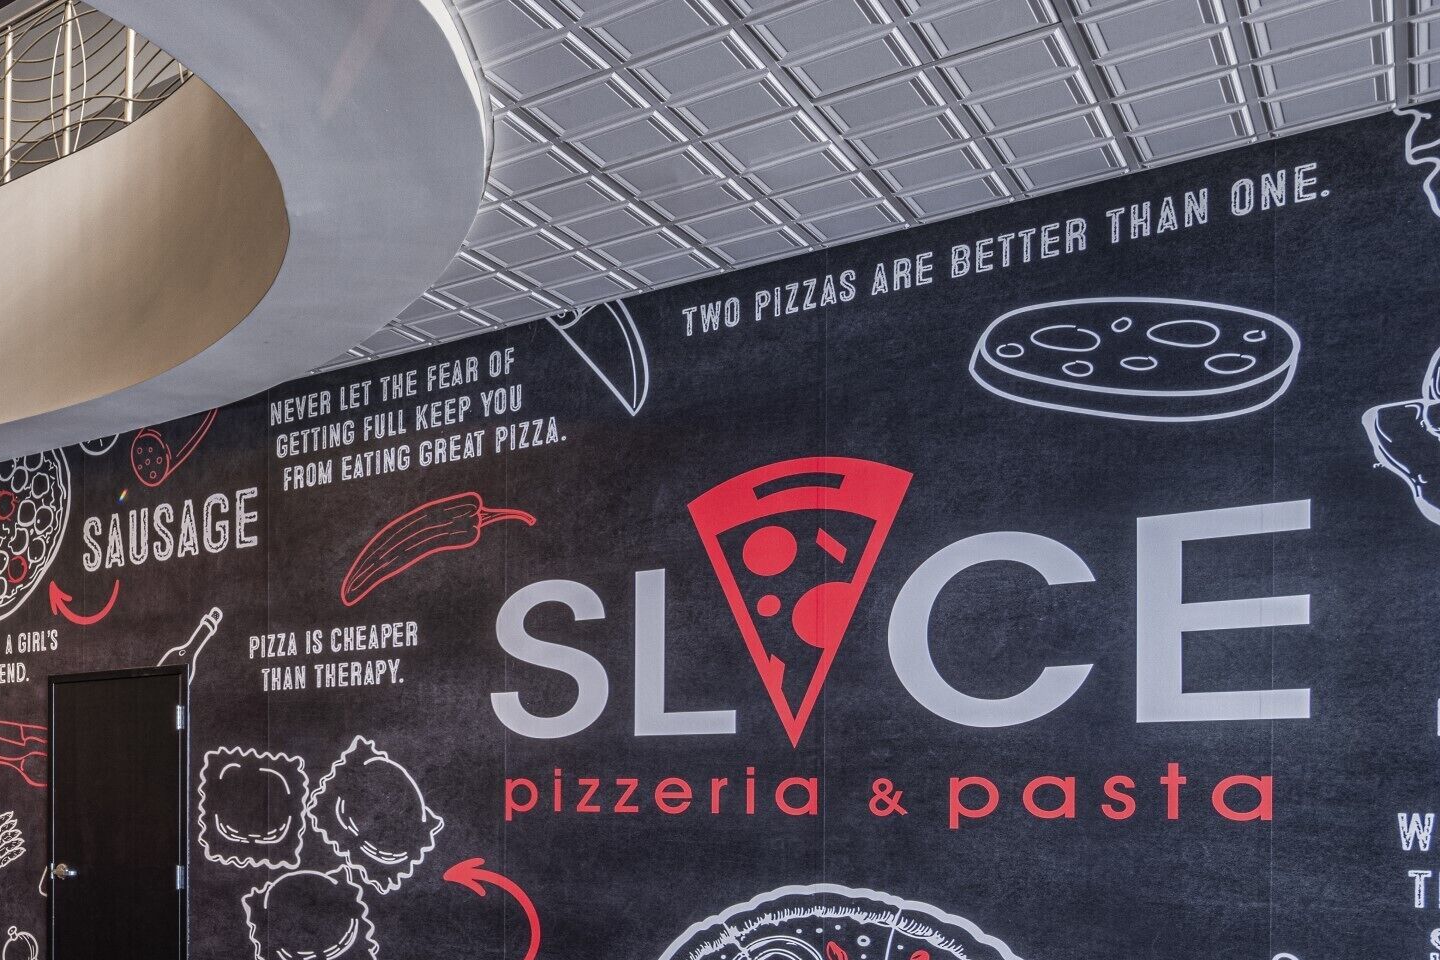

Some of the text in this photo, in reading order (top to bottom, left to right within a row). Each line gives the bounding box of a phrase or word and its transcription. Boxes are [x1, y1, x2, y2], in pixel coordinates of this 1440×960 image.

[682, 162, 1331, 338] TWO PIZZAS ARE BETTER THAN ONE.
[270, 346, 515, 426] NEVER LET THE FEAR OF
[276, 383, 522, 459] GETTING FULL KEEP YOU
[283, 416, 567, 492] FROM EATING GREAT PIZZA.
[82, 486, 259, 574] SAUSAGE
[5, 633, 13, 655] A
[17, 628, 59, 654] GIRL'S
[250, 620, 419, 660] PIZZA IS CHEAPER
[260, 658, 404, 692] THAN THERAPY.
[504, 762, 1273, 830] pizzeria & pasta
